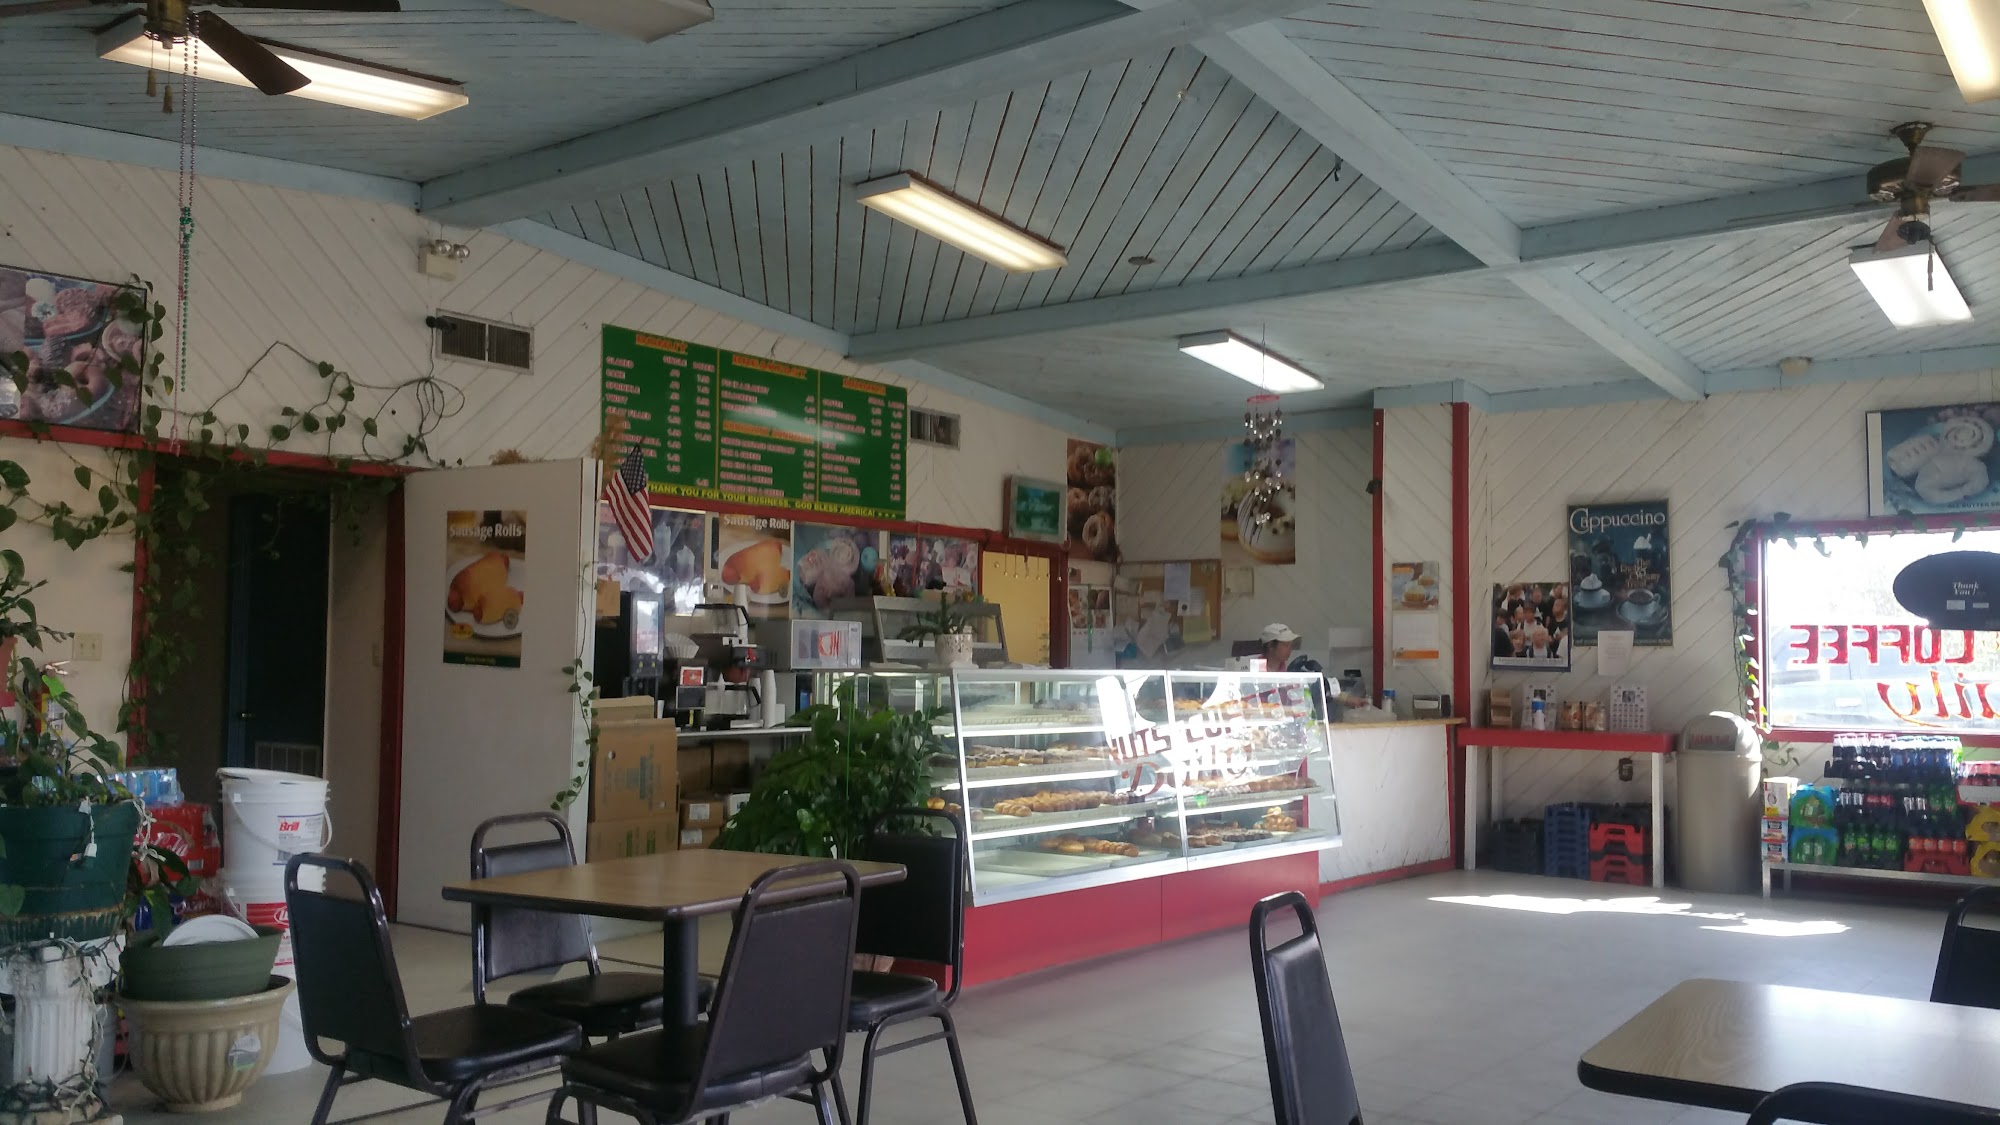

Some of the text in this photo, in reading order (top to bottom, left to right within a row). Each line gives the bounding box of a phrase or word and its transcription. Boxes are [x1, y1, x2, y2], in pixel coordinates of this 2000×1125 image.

[648, 484, 677, 495] THANK
[680, 487, 698, 497] YOU
[702, 489, 719, 500] FOR
[722, 492, 745, 502] YOUR
[796, 501, 812, 510] GOD
[814, 502, 838, 513] BLESS
[840, 507, 875, 517] AMERICA!
[724, 514, 790, 530] Sausage Rolls
[1569, 508, 1666, 534] Cappuccino
[450, 523, 522, 541] Sausage Rolls
[1953, 581, 1979, 590] Thank
[280, 821, 300, 832] Brill
